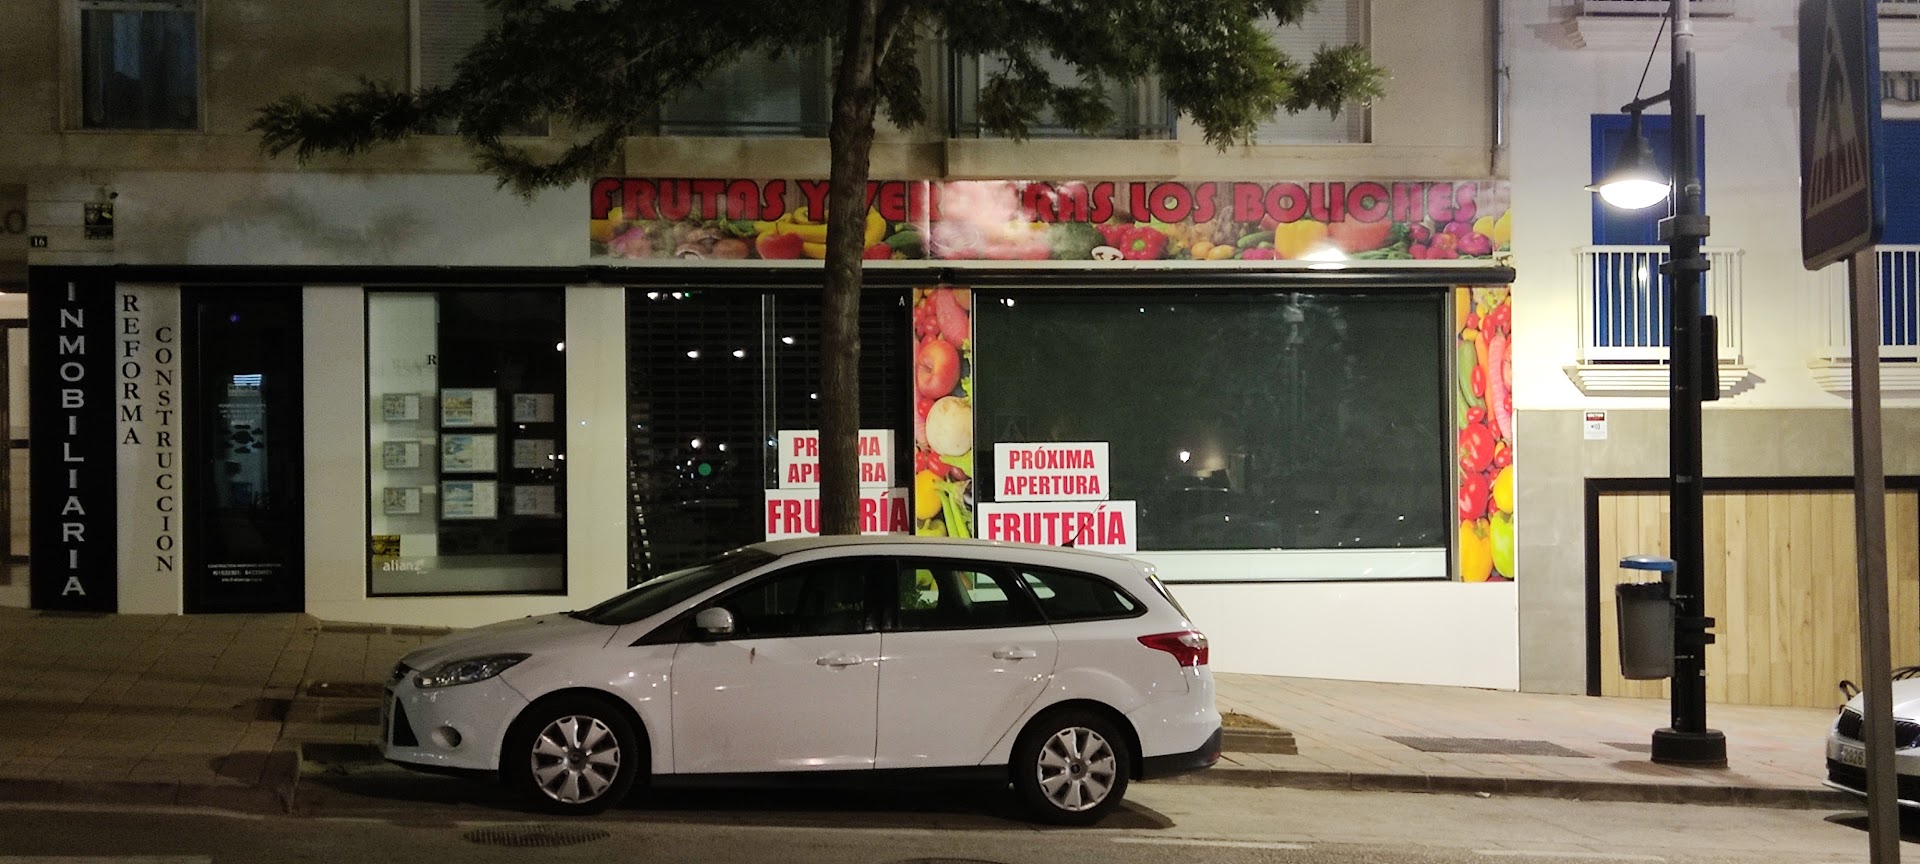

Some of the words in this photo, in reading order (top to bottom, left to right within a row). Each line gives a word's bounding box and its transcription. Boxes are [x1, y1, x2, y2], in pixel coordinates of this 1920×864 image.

[591, 177, 786, 222] FRUTAS
[796, 178, 830, 222] Y
[1129, 181, 1217, 224] LOS
[1232, 181, 1477, 224] BOLICHES
[33, 237, 46, 247] 16
[121, 294, 144, 445] REFORMA
[59, 281, 87, 597] INMOBILIARIA
[154, 326, 174, 573] CONSTRUCCION
[793, 436, 881, 457] PRMA
[1009, 446, 1095, 469] PRÓXIMA
[1003, 475, 1100, 495] APERTURA
[767, 491, 910, 534] FRURÍA
[987, 504, 1127, 547] FRUTERÍA
